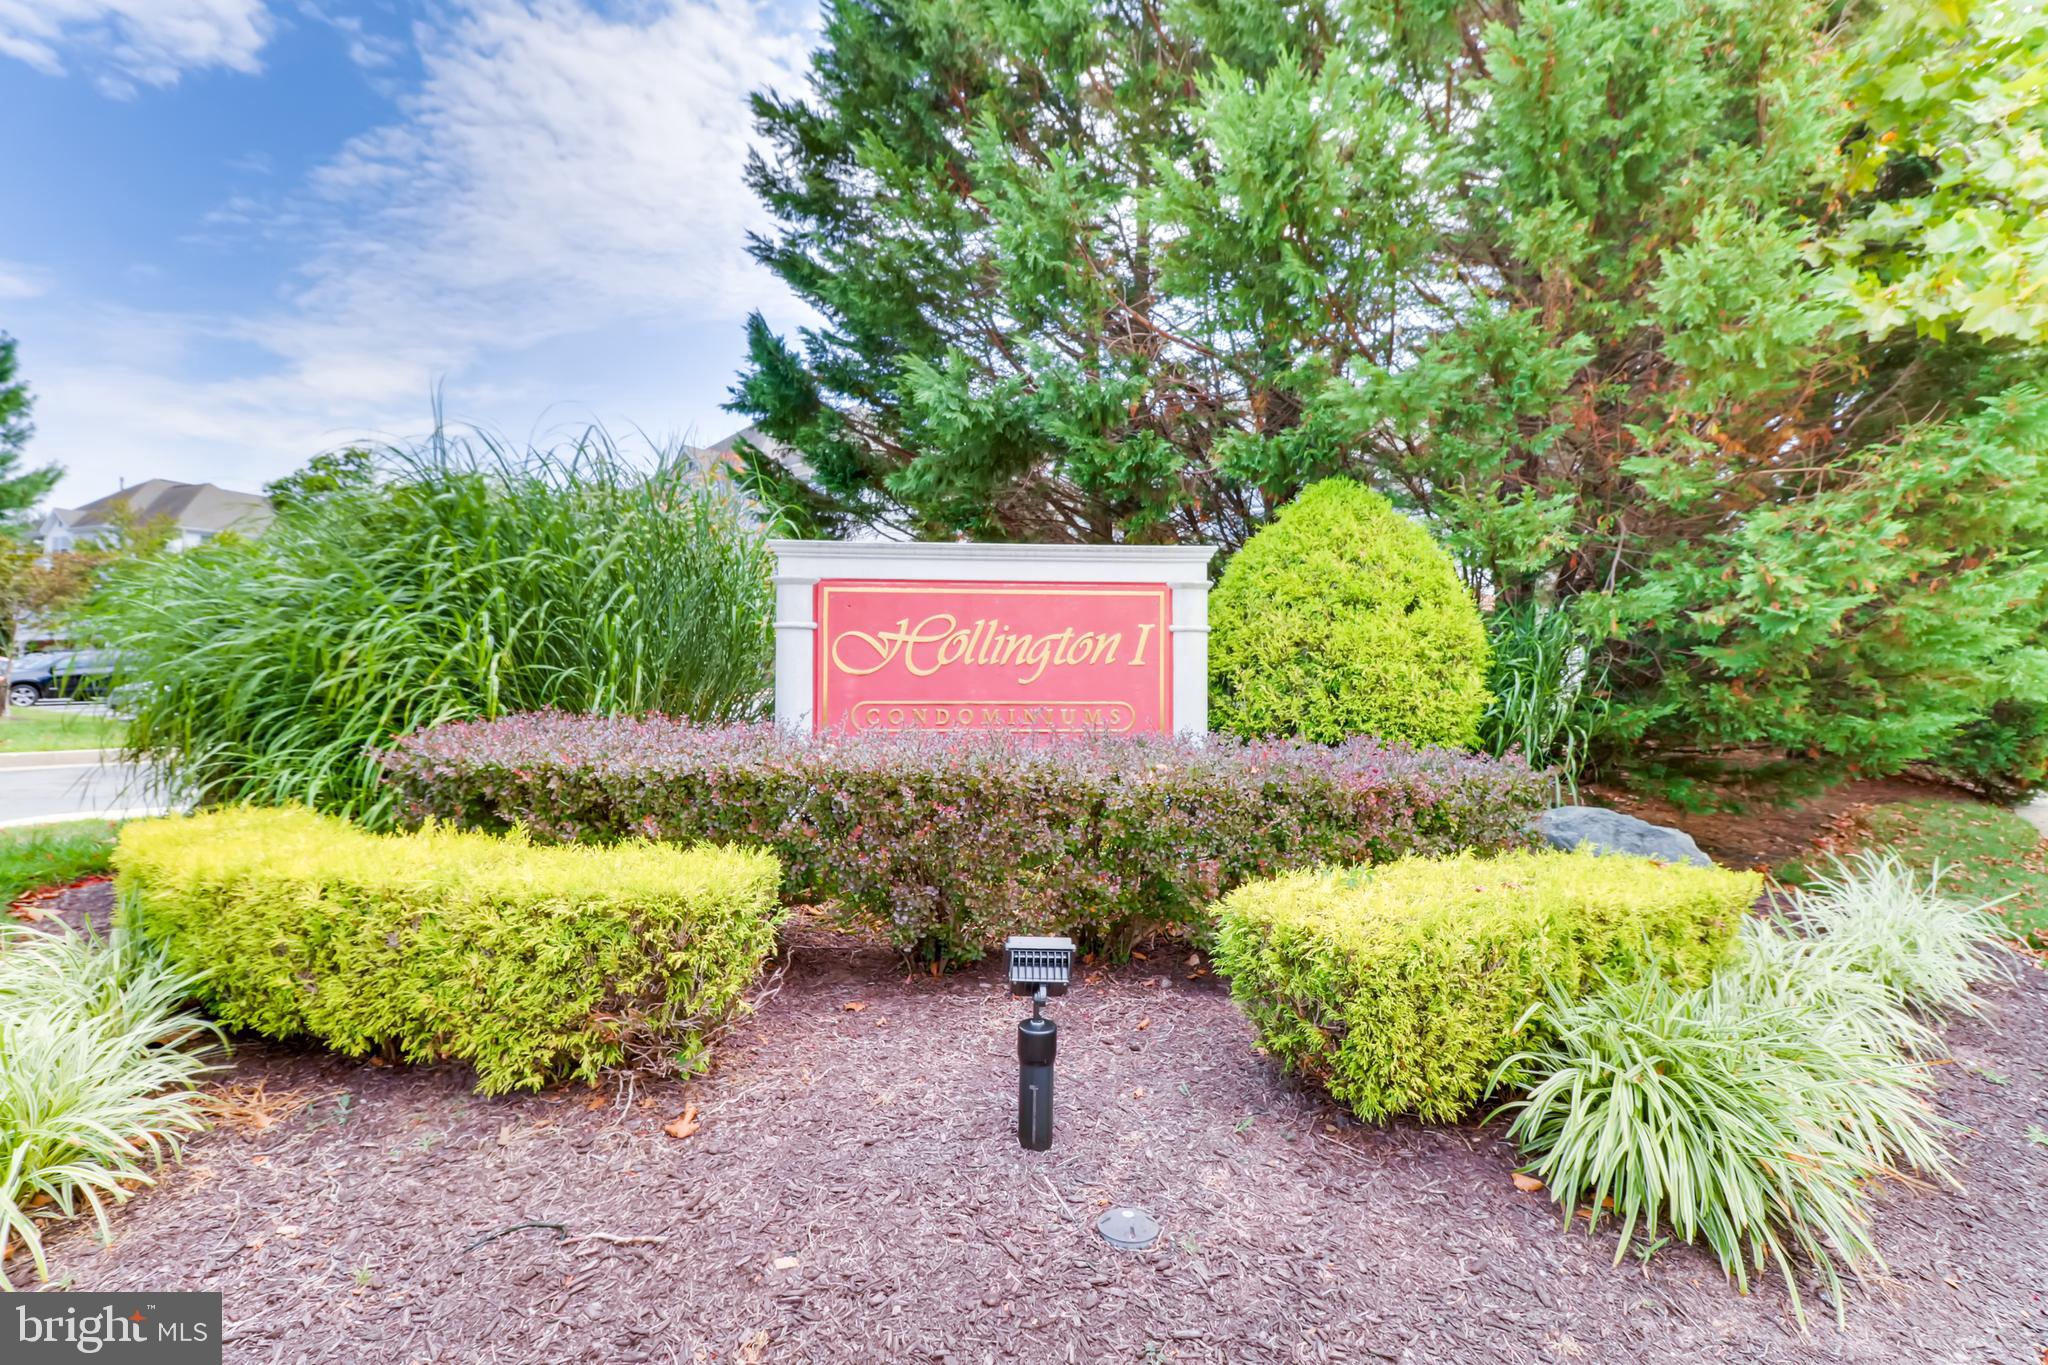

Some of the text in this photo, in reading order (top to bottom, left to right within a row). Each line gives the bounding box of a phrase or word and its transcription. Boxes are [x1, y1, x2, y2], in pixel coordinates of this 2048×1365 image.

[831, 613, 1155, 685] Hollington I
[866, 708, 1121, 725] CONDOMINIUMS
